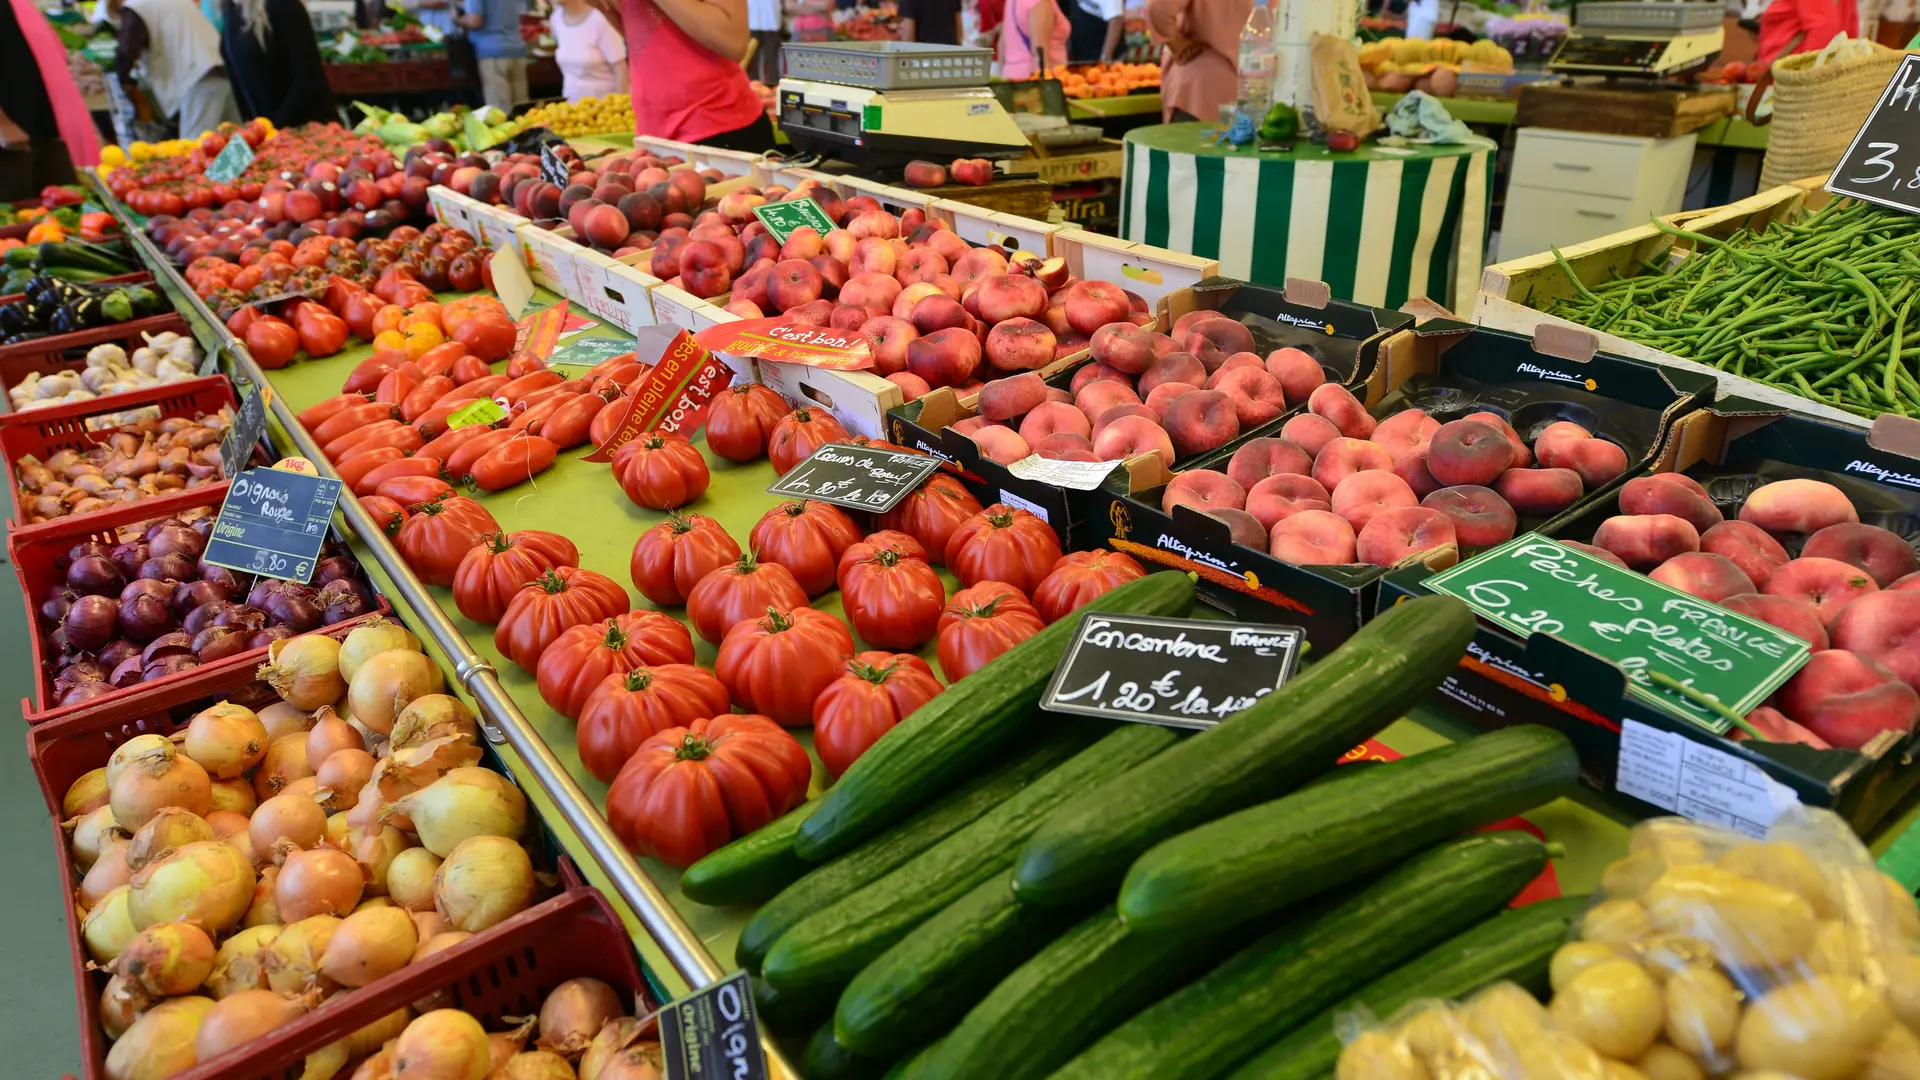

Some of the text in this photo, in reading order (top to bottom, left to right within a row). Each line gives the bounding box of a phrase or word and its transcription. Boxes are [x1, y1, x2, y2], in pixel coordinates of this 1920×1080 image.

[769, 326, 862, 349] C'est bon!
[660, 358, 680, 381] en
[631, 376, 667, 425] pleine
[284, 459, 306, 472] 1kg
[216, 520, 246, 539] Origine
[295, 561, 309, 577] €
[1510, 543, 1645, 612] Pêches
[1464, 578, 1565, 636] 6,20
[1660, 597, 1799, 660] FRANCE
[1622, 616, 1735, 672] Plates
[1056, 670, 1156, 713] 1,20
[1150, 669, 1183, 698] €
[681, 1003, 702, 1074] Origine
